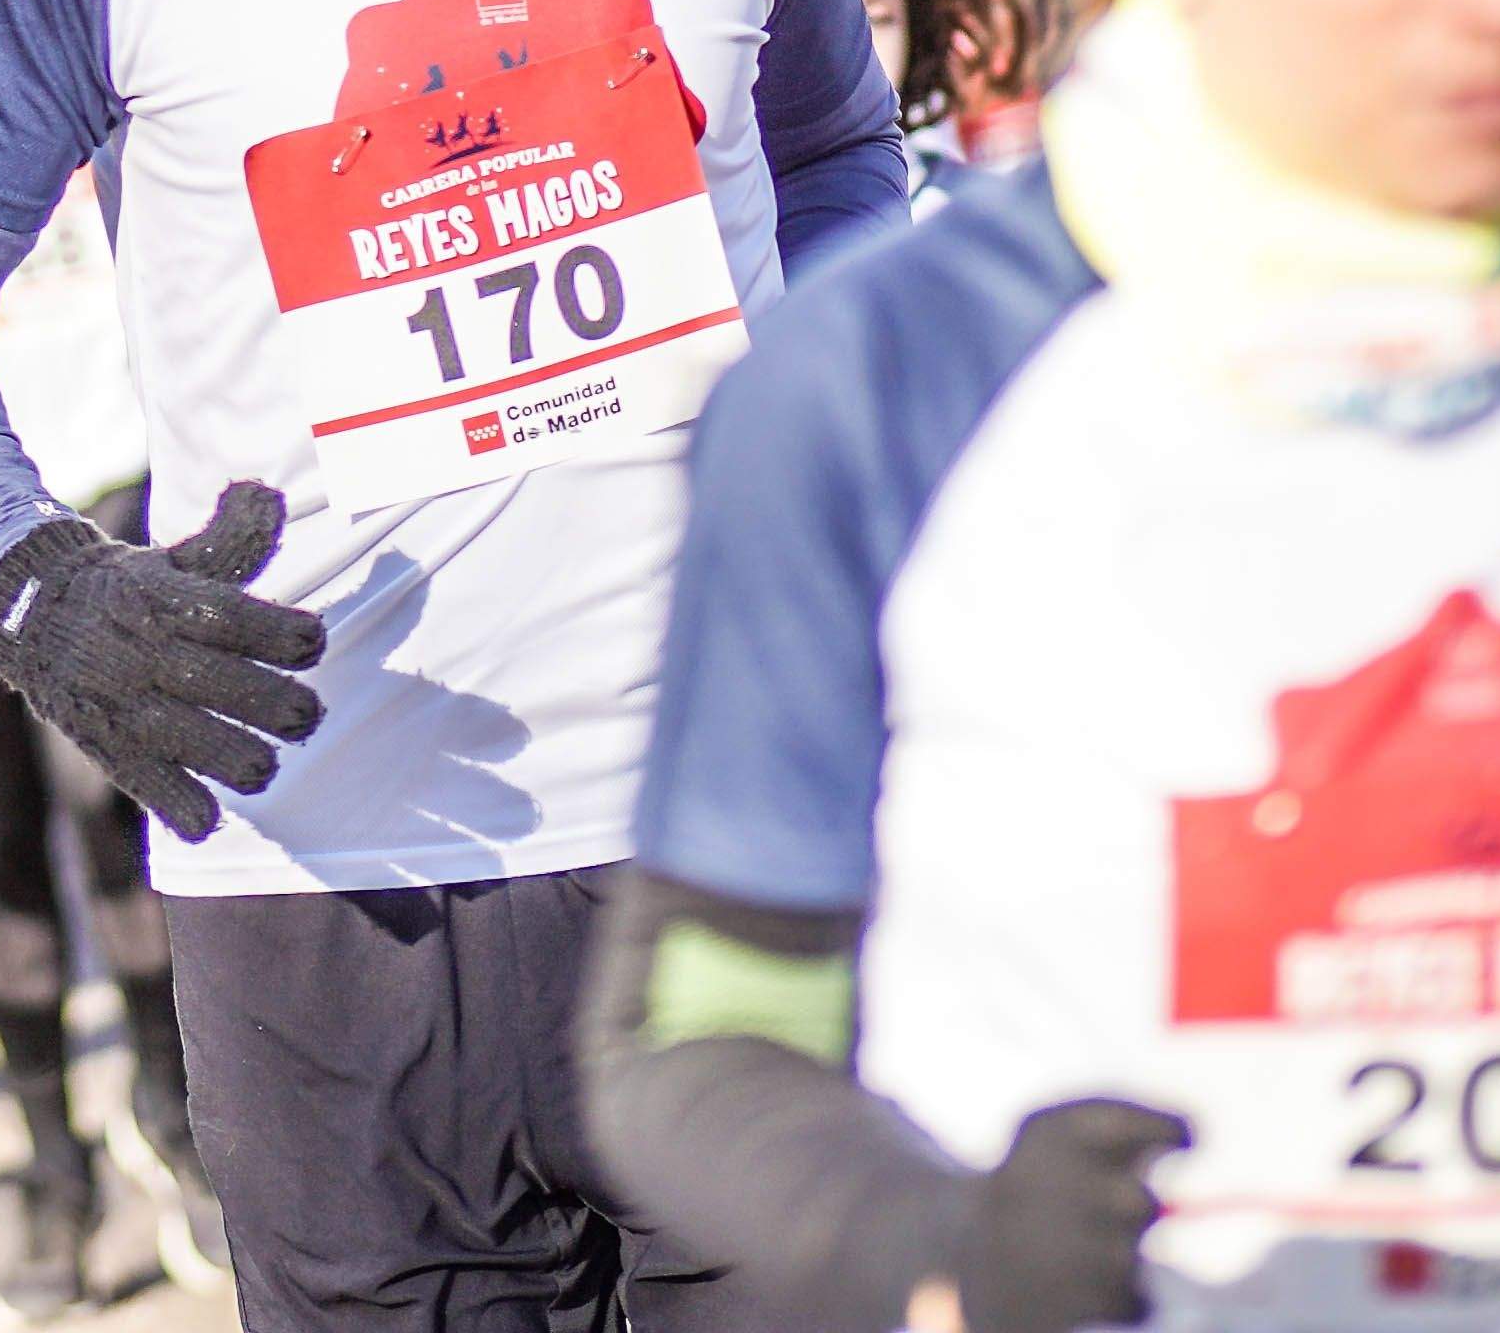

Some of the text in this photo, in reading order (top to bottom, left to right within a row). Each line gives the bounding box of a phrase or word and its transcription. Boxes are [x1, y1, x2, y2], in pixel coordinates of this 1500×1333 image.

[380, 141, 576, 209] CARRERA POPULAR
[349, 159, 624, 281] REYES MAGOS
[405, 243, 626, 383] 170
[506, 376, 617, 421] Comunidad
[512, 397, 622, 444] de Madrid
